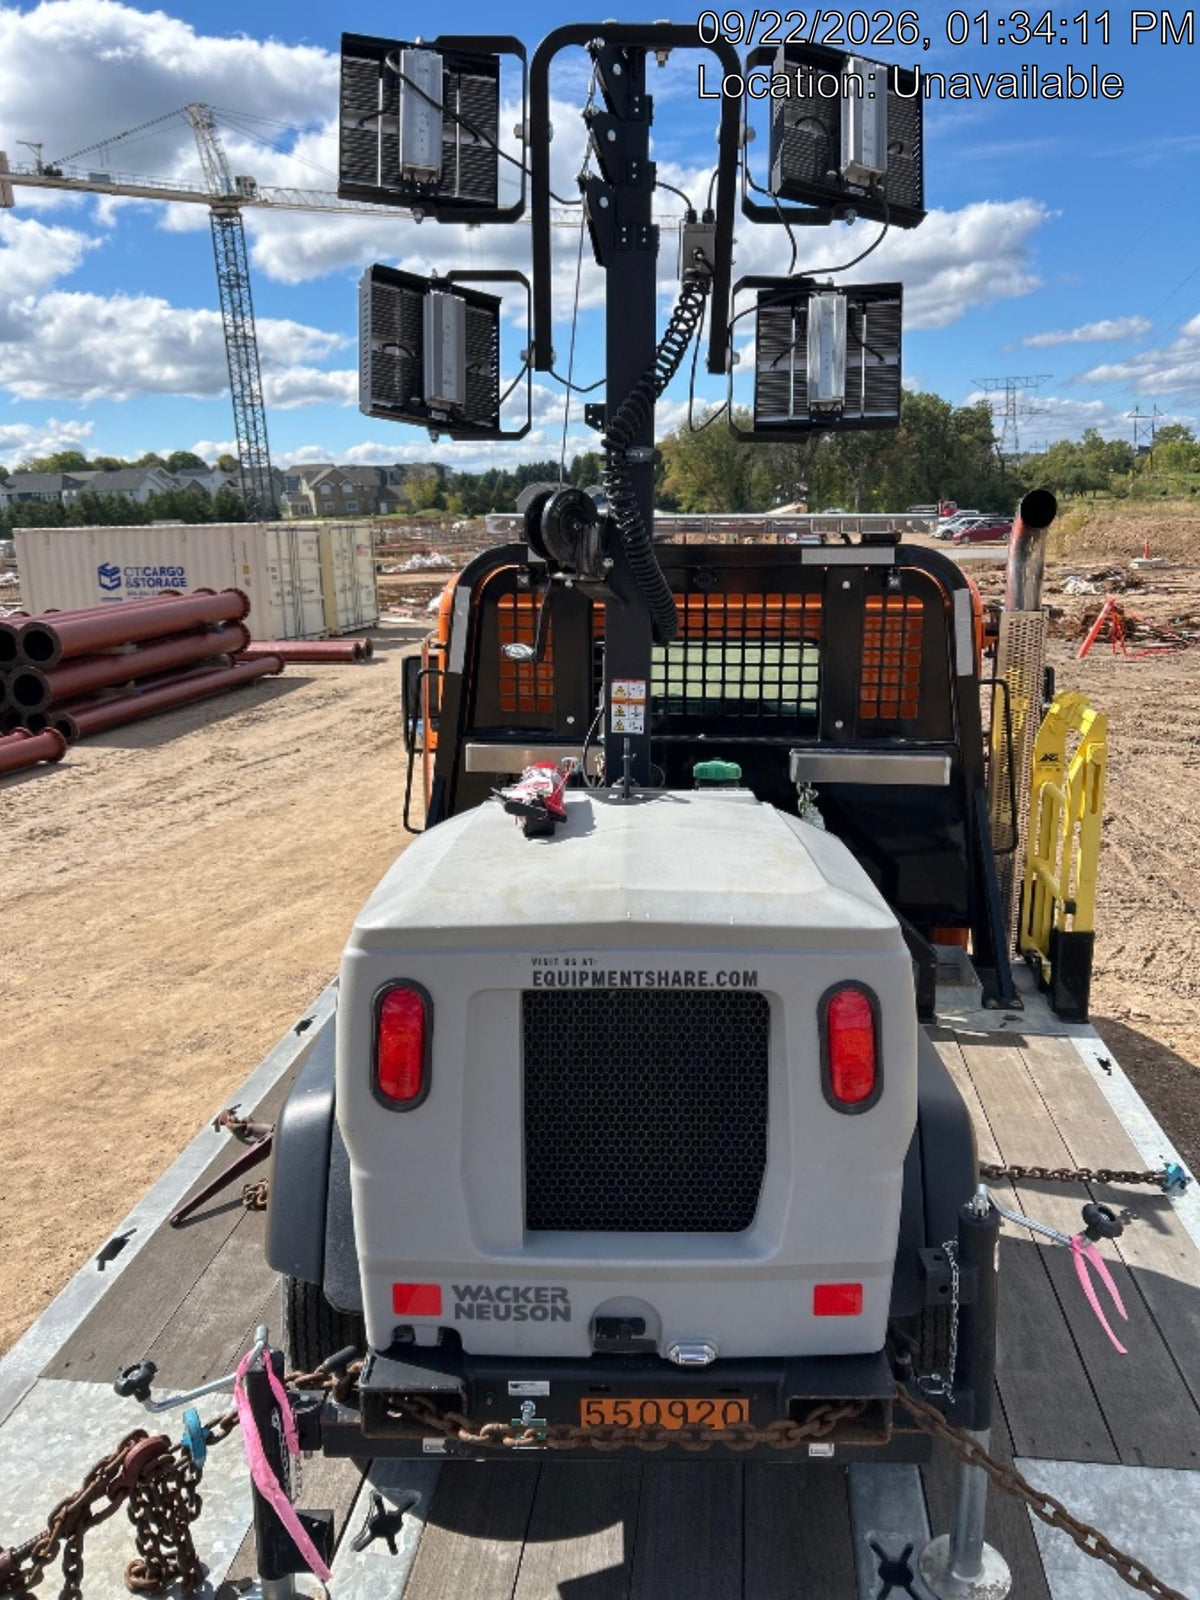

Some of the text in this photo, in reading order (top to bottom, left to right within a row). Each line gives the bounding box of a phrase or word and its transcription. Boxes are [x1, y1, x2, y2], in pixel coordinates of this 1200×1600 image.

[531, 957, 559, 966] VISIT
[563, 957, 577, 966] US
[532, 970, 759, 988] EQUIPMENTSHARE.COM
[452, 1284, 571, 1304] WACKER
[454, 1303, 572, 1322] NEUSON
[585, 1400, 745, 1427] 550920
